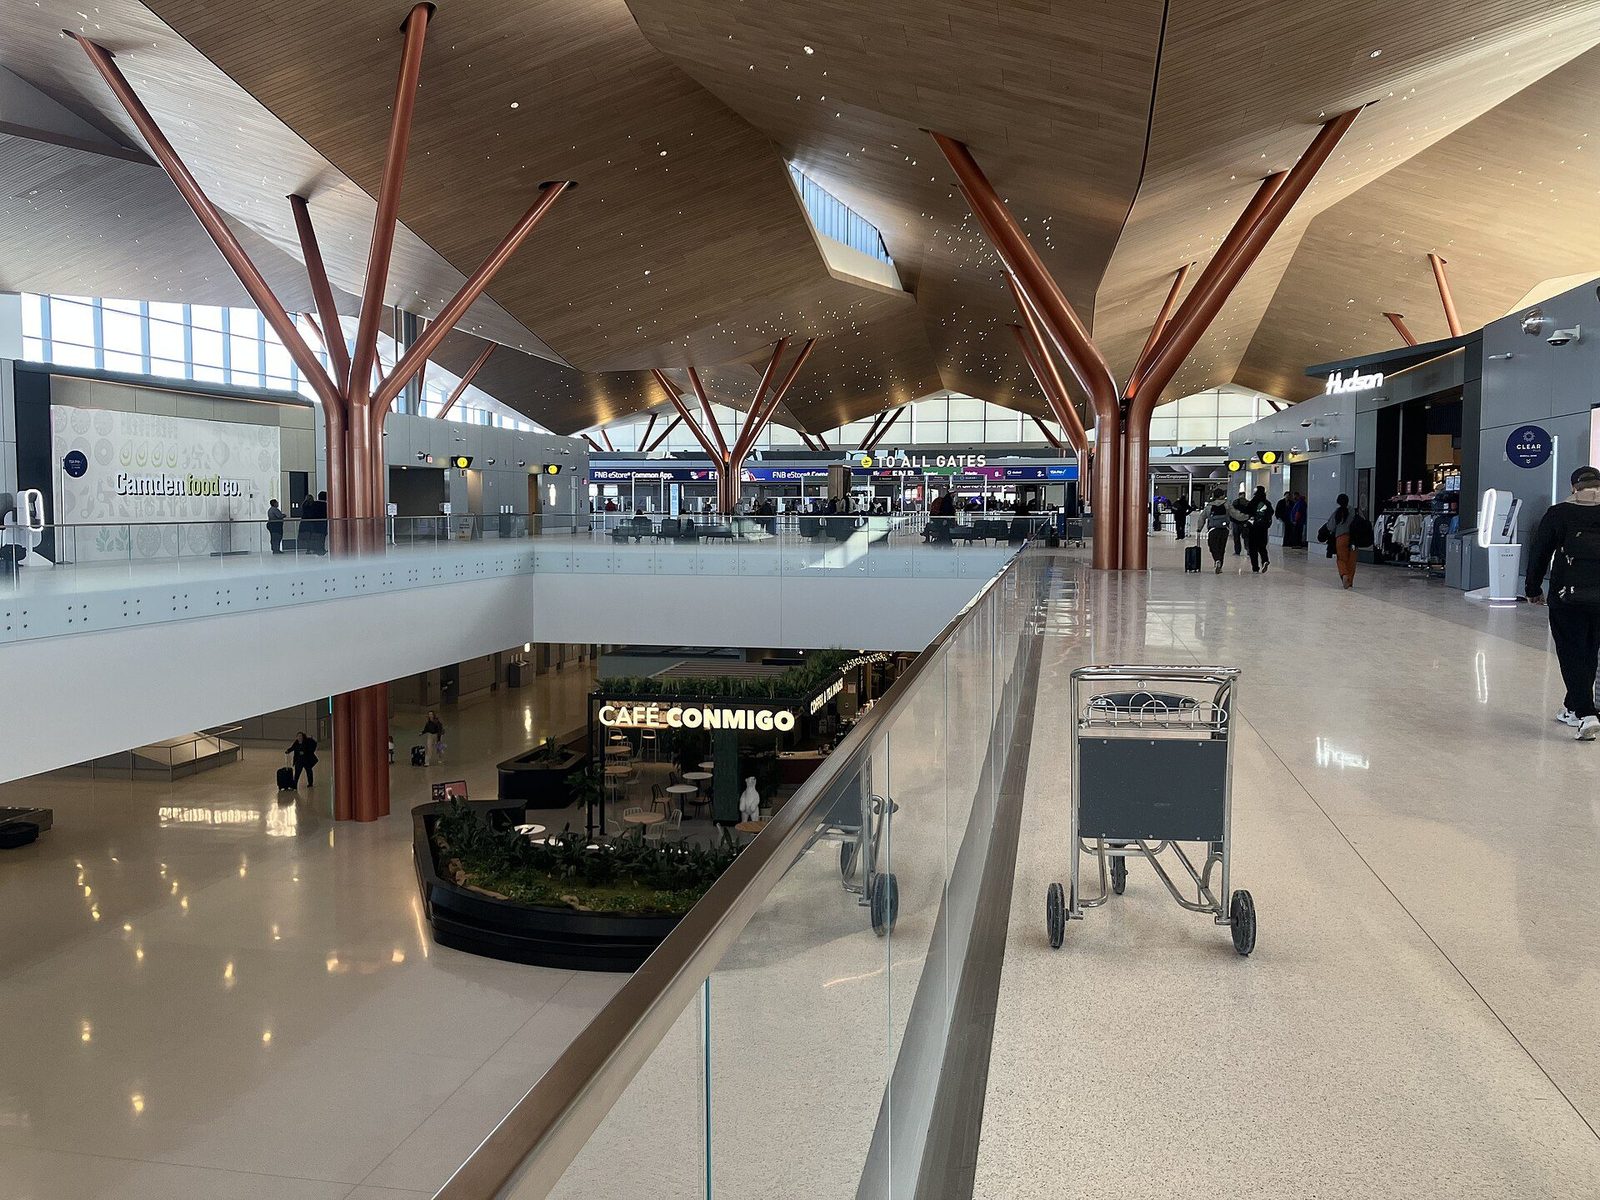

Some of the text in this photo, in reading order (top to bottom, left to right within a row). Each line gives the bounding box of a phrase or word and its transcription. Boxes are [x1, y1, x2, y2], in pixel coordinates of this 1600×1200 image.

[1326, 369, 1384, 395] Hudson
[876, 455, 986, 468] TO ALL GATES
[115, 472, 242, 497] Camden food co.
[594, 471, 608, 479] FNB
[772, 471, 787, 479] FNB
[598, 702, 796, 732] CAFÉ CONMIGO
